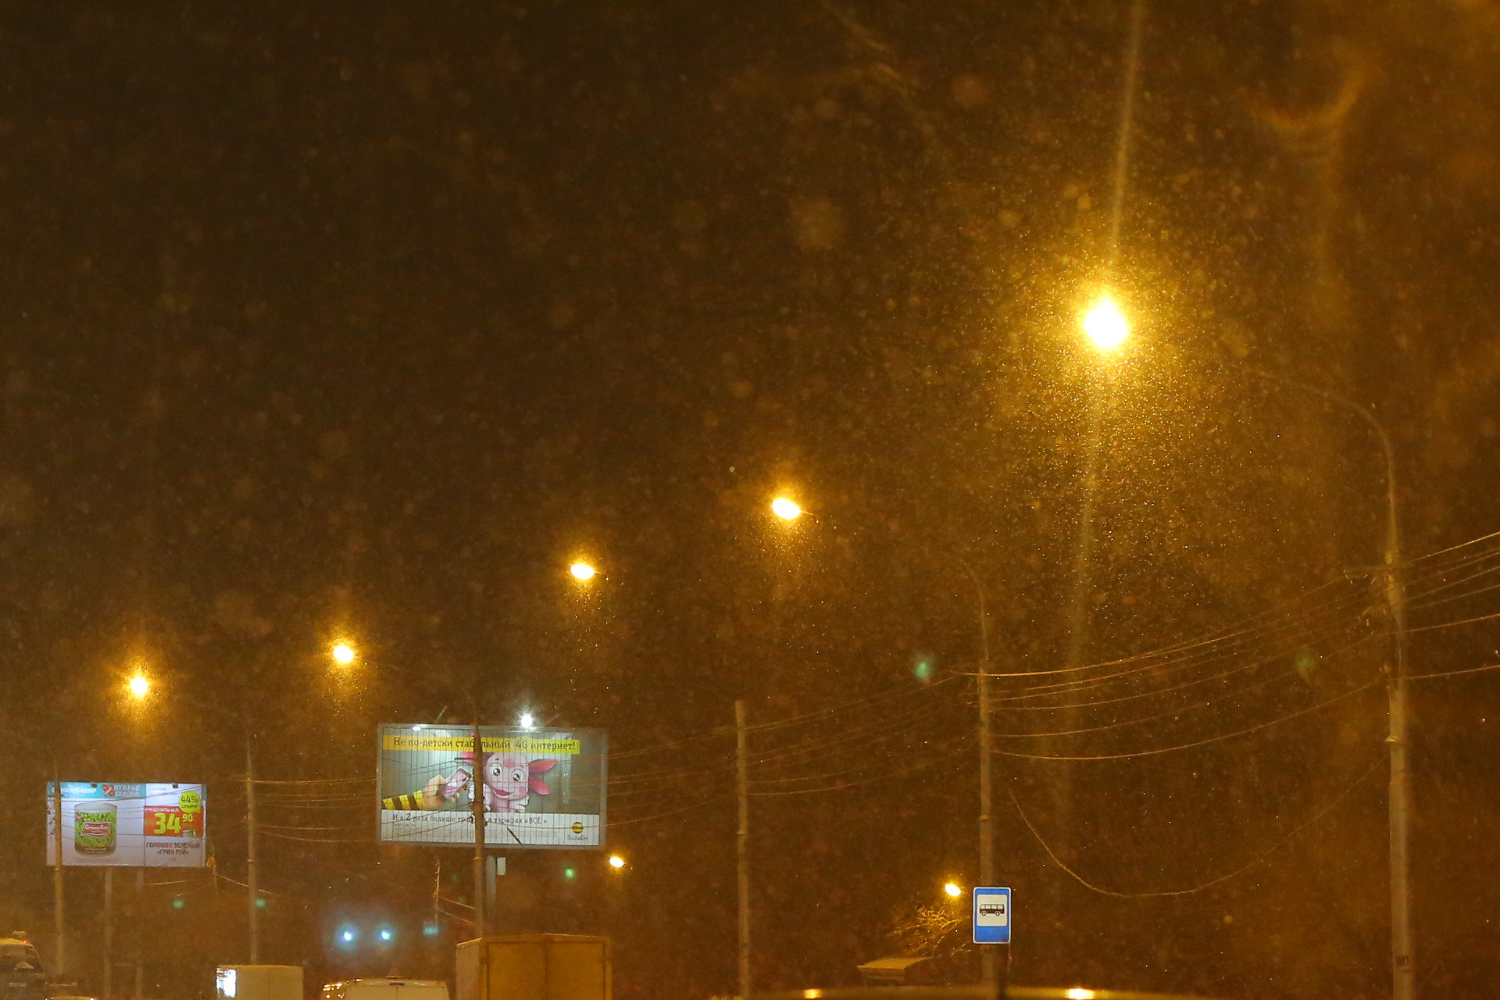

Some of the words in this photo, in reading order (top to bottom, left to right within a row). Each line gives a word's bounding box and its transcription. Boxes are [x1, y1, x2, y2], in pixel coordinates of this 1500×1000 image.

[393, 737, 406, 746] Не
[408, 738, 453, 748] по-детски
[455, 738, 510, 749] стабльный
[515, 739, 528, 749] 4G
[530, 740, 576, 751] интернет!
[154, 812, 181, 835] 34
[182, 813, 194, 823] 90
[406, 813, 411, 821] 2
